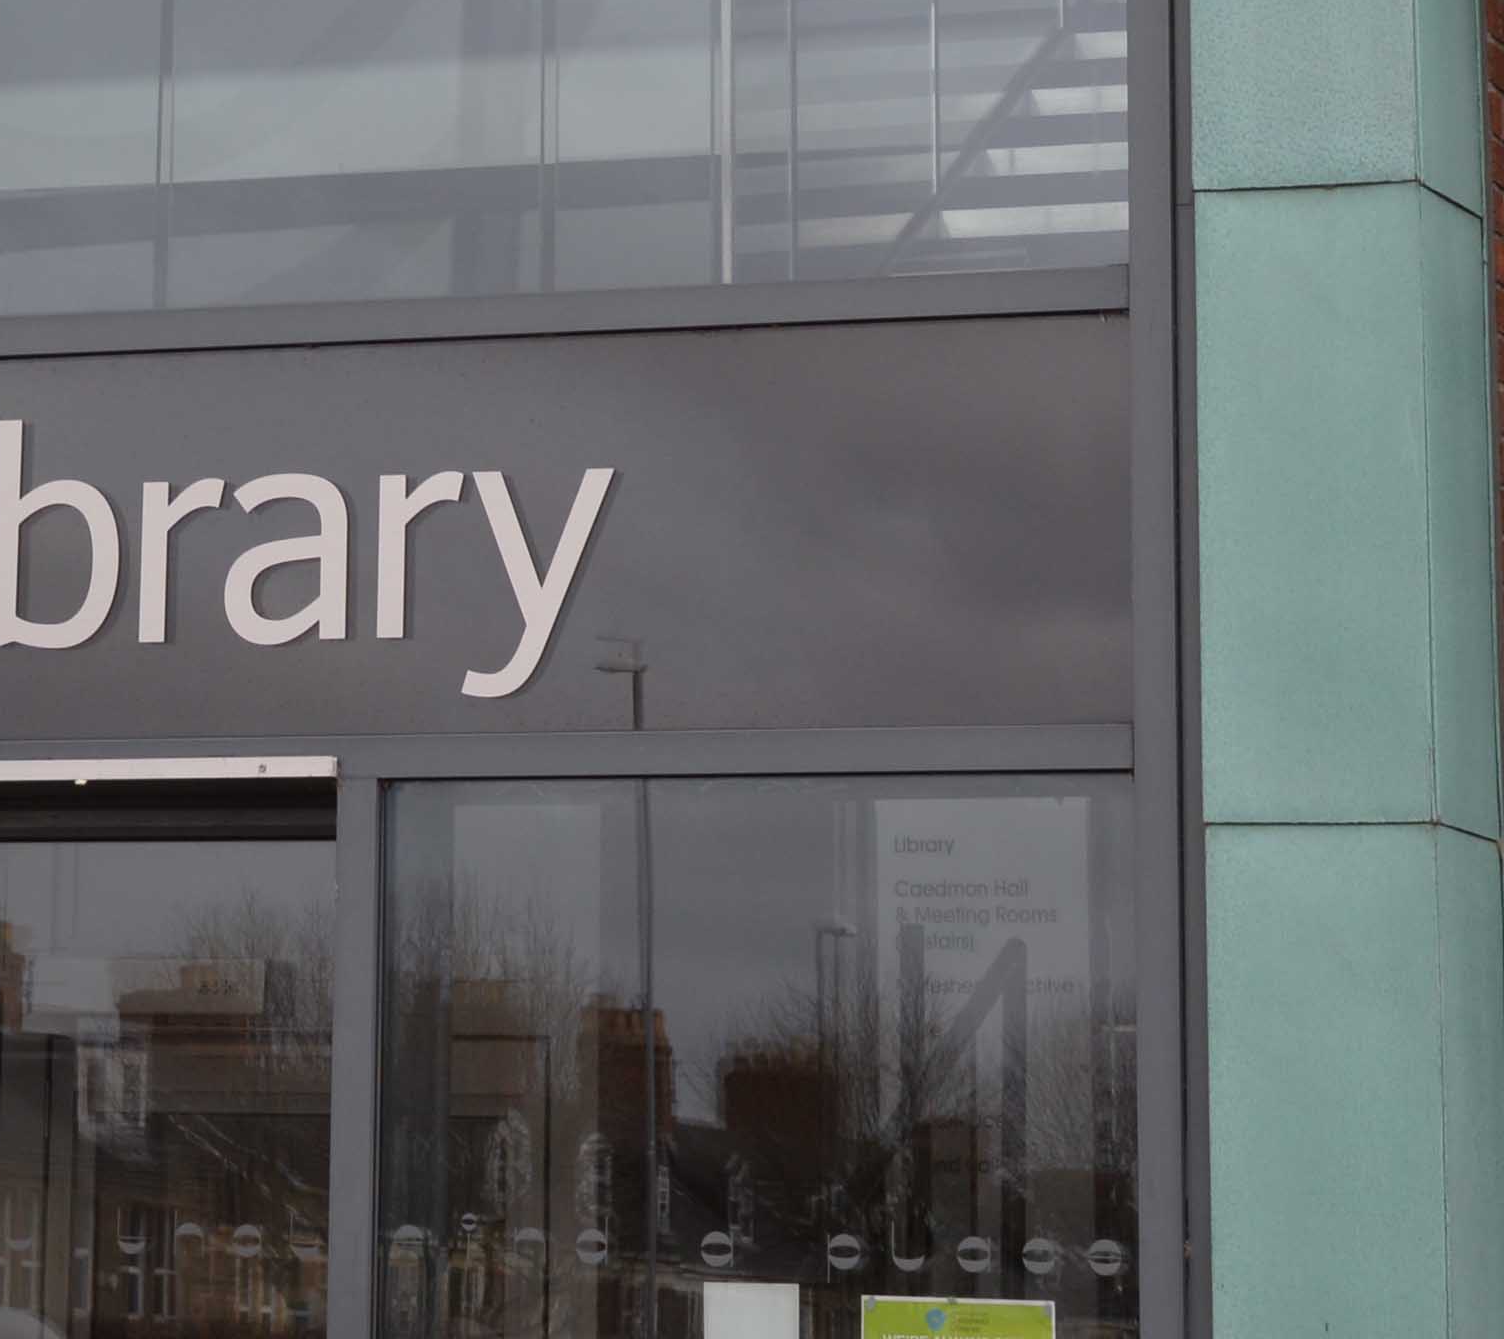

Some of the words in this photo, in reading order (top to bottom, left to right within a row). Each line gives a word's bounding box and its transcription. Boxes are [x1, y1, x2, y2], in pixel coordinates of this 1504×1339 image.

[894, 835, 955, 856] Library
[993, 877, 1030, 898] Hall
[896, 906, 909, 923] &
[915, 906, 990, 927] Meeting
[995, 906, 1057, 923] Rooms
